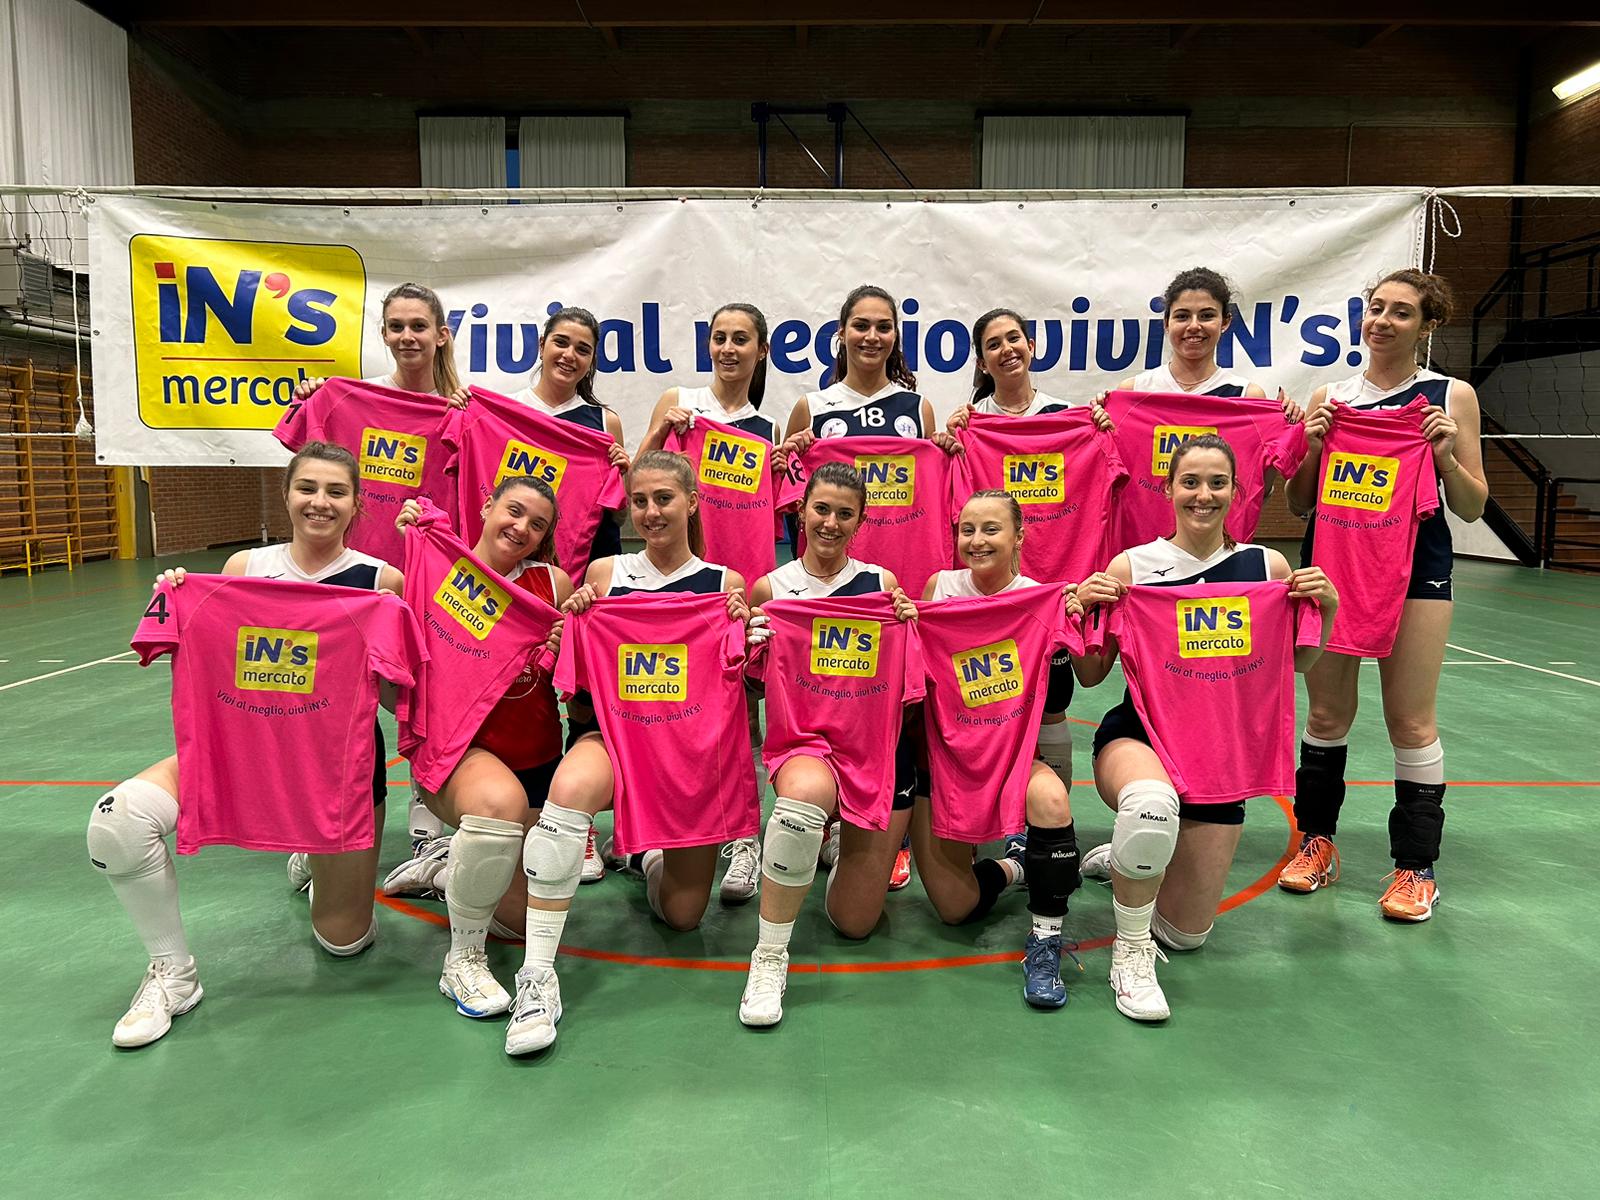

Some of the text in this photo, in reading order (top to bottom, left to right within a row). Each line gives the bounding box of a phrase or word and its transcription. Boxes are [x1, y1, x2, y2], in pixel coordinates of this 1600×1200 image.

[154, 262, 338, 346] iN's
[1215, 295, 1364, 369] N's!
[163, 368, 328, 406] merca
[853, 406, 886, 428] 18
[367, 435, 418, 463] iN's
[708, 438, 757, 469] iN's
[365, 464, 415, 480] mercato
[506, 447, 557, 482] iN's
[860, 462, 908, 484] iN's
[1009, 461, 1058, 482] iN's
[1332, 459, 1389, 487] iN's
[705, 468, 753, 486] mercato
[1010, 486, 1058, 498] mercato
[1329, 489, 1384, 505] mercato
[1022, 515, 1045, 524] eglio,
[451, 566, 499, 616] iN's
[144, 592, 170, 624] 4
[442, 591, 485, 631] mercato
[1184, 606, 1243, 632] iN's
[819, 624, 872, 652] iN's
[1186, 636, 1244, 650] mercato
[245, 635, 308, 665] iN's
[625, 651, 680, 675] iN's
[817, 657, 870, 670] mercato
[960, 652, 1014, 682] iN's
[1164, 660, 1182, 674] Vivi
[1183, 669, 1192, 678] al
[1195, 671, 1231, 683] meglio,
[243, 671, 306, 685] mercato
[625, 681, 680, 694] mercato
[969, 679, 1018, 700] mercato
[217, 689, 236, 705] Vivi
[236, 700, 246, 710] al
[248, 703, 286, 717] meglio,
[288, 703, 308, 715] vivi
[811, 684, 820, 693] al
[821, 688, 853, 700] meglio,
[621, 711, 631, 719] al
[632, 713, 665, 725] meglio,
